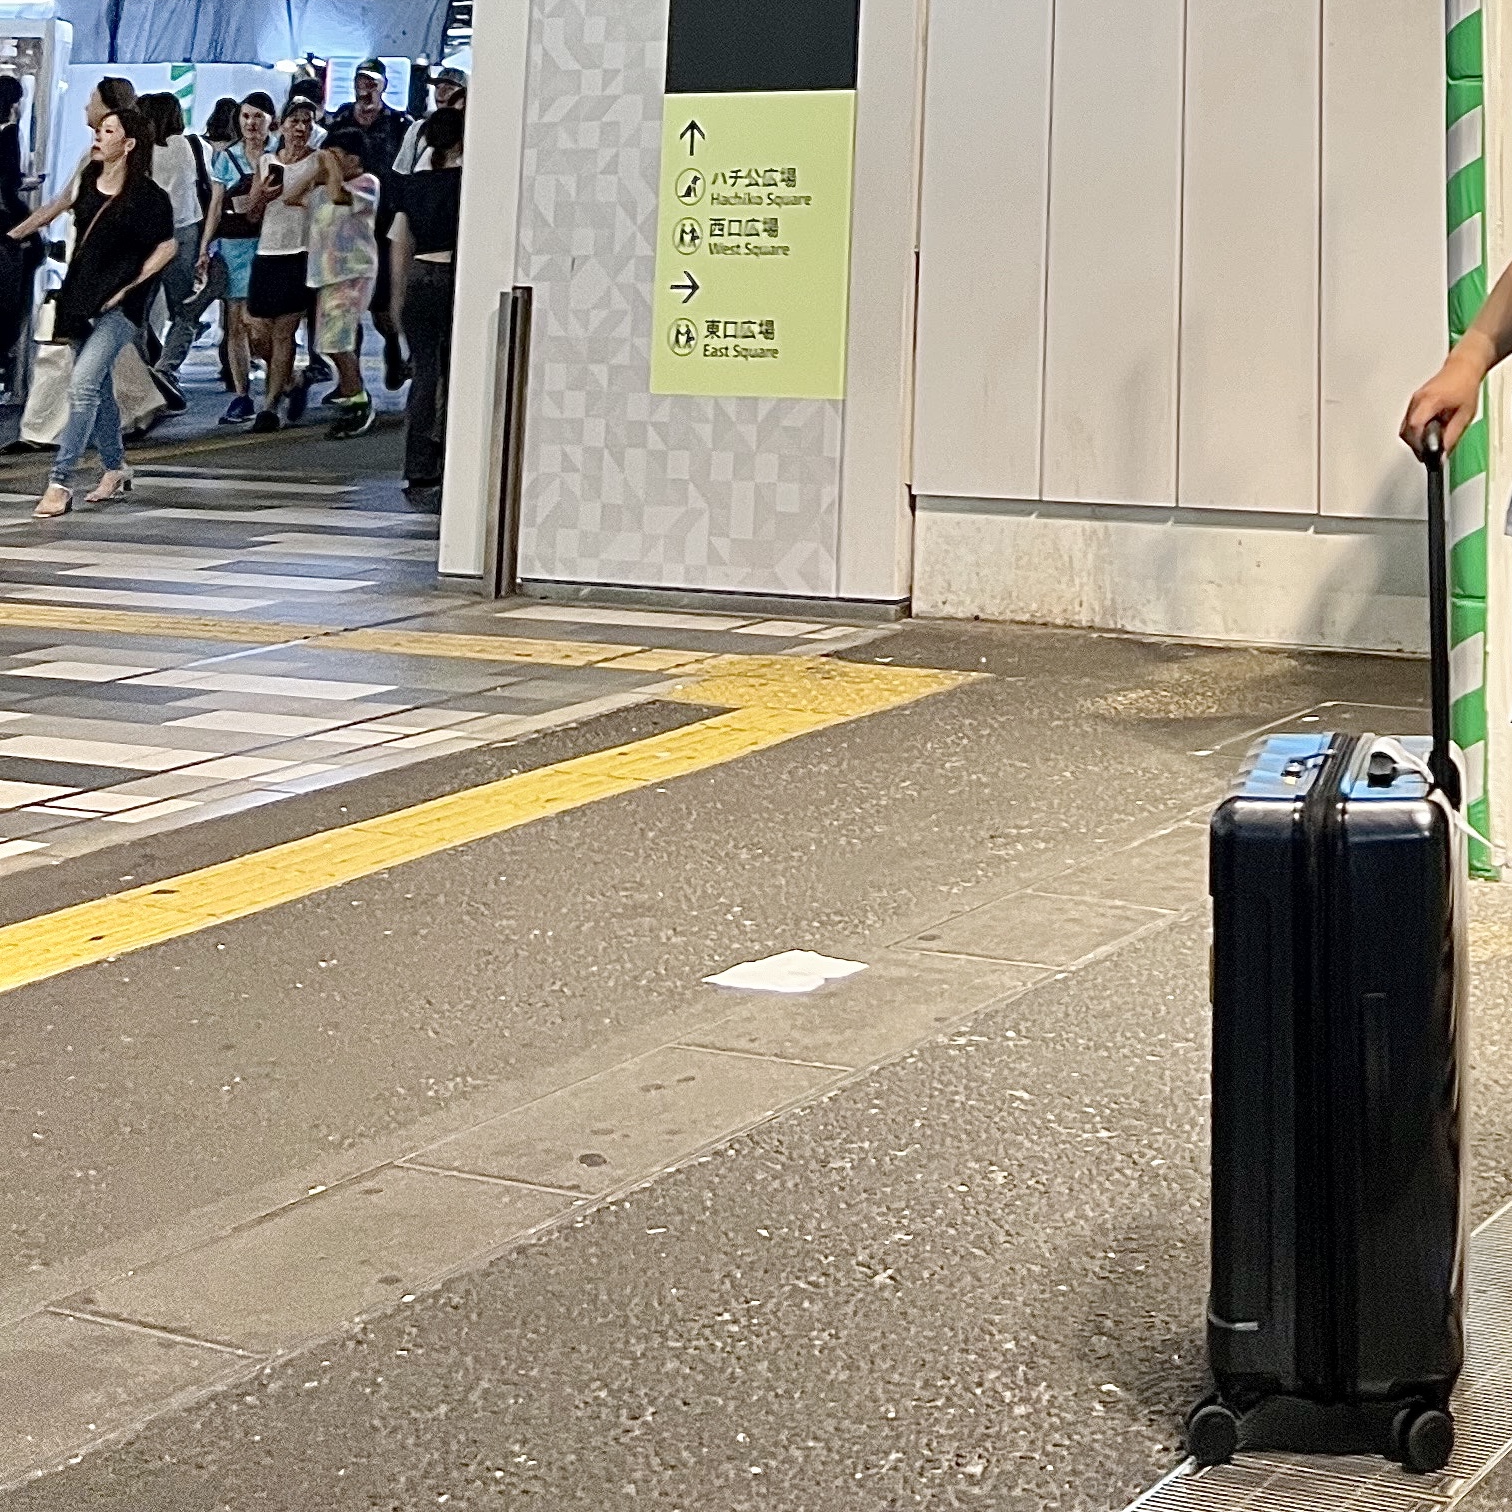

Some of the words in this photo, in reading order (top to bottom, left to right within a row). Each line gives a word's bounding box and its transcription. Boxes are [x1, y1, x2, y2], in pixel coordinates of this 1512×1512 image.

[711, 167, 797, 187] ハチ公広場
[767, 192, 812, 208] Square
[709, 217, 778, 238] 西口広場
[709, 242, 742, 256] West
[745, 242, 790, 258] Square
[704, 319, 775, 341] 東口広場
[703, 344, 730, 358] East
[732, 345, 779, 361] Square
